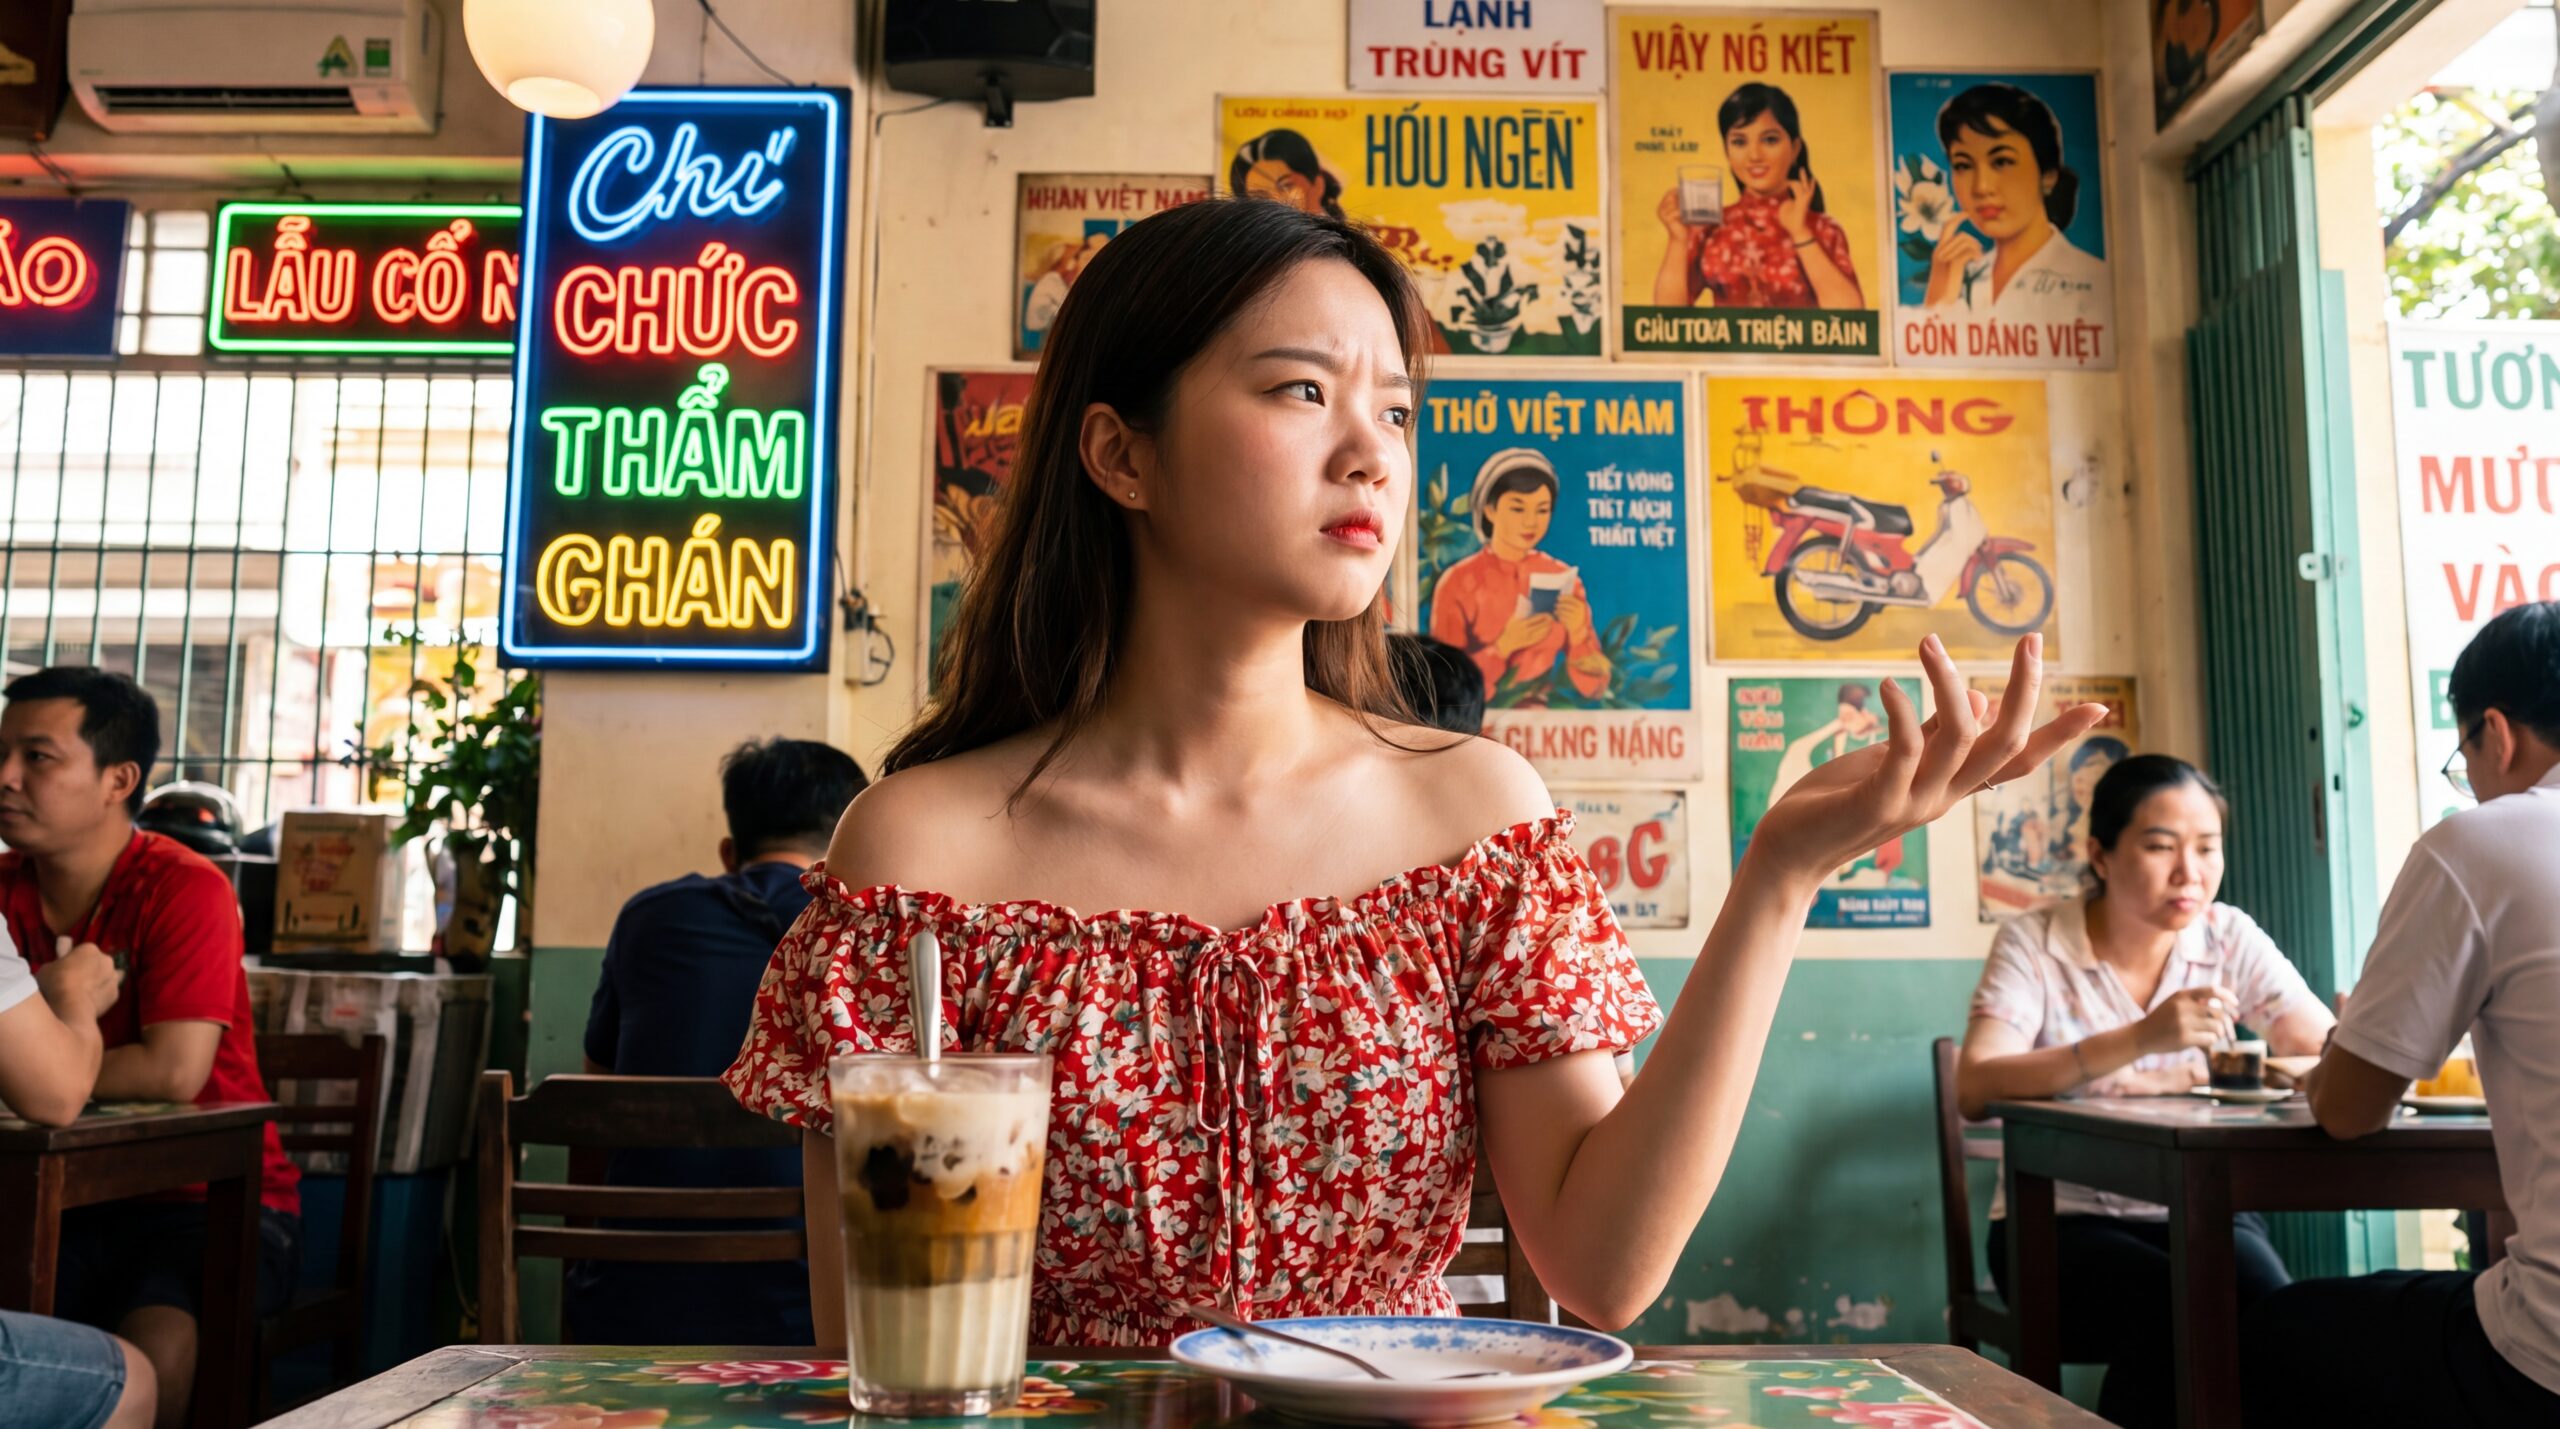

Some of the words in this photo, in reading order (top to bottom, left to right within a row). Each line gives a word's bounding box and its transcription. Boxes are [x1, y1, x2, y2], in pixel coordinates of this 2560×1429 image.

[1522, 40, 1587, 79] VÍT
[554, 242, 798, 357] CHỨC
[541, 363, 805, 499] THẨM
[1508, 391, 1586, 442] VIỆT
[1742, 388, 2015, 436] THÔNG
[536, 512, 795, 629] GHÁN
